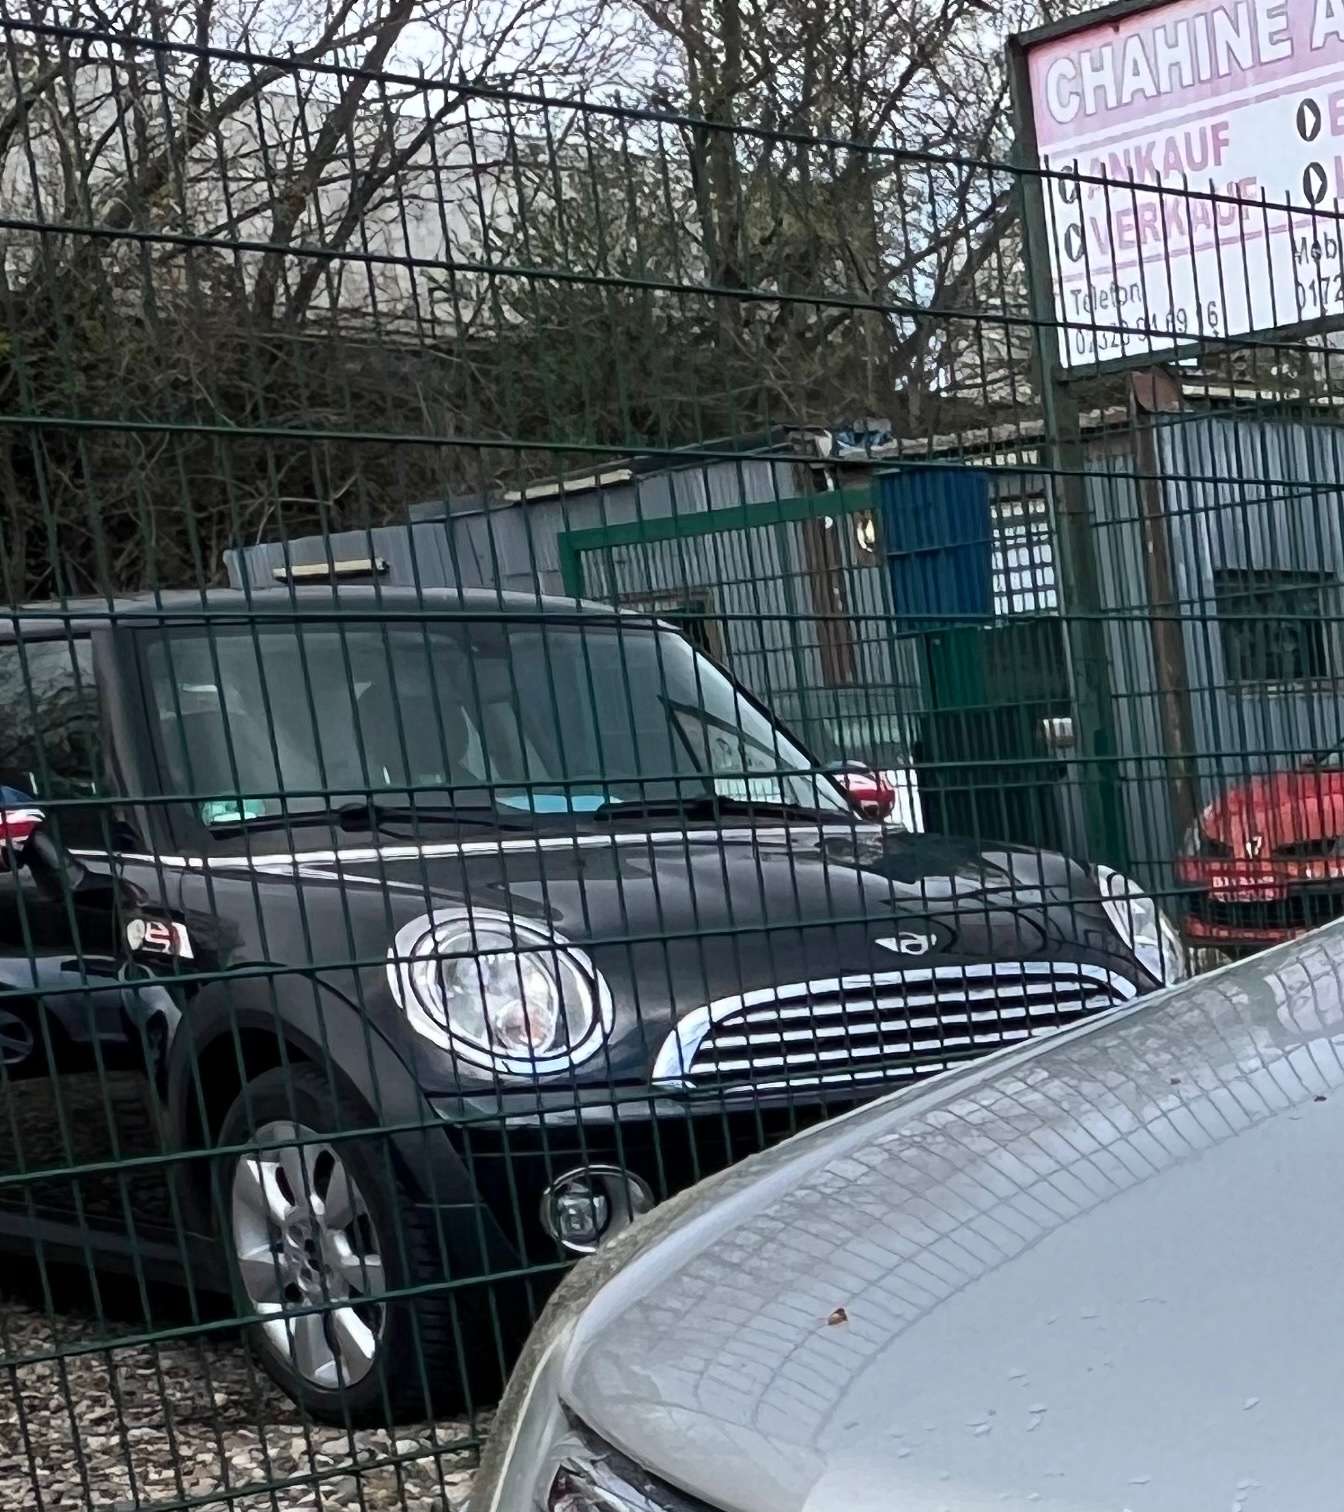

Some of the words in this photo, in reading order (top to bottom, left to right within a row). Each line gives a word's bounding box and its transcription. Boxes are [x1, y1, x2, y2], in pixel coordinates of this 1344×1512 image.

[1045, 0, 1294, 124] CHAHINE
[1088, 121, 1230, 200] ANKAUF
[1089, 176, 1258, 255] VERKAUF
[1070, 281, 1143, 315] Telefon
